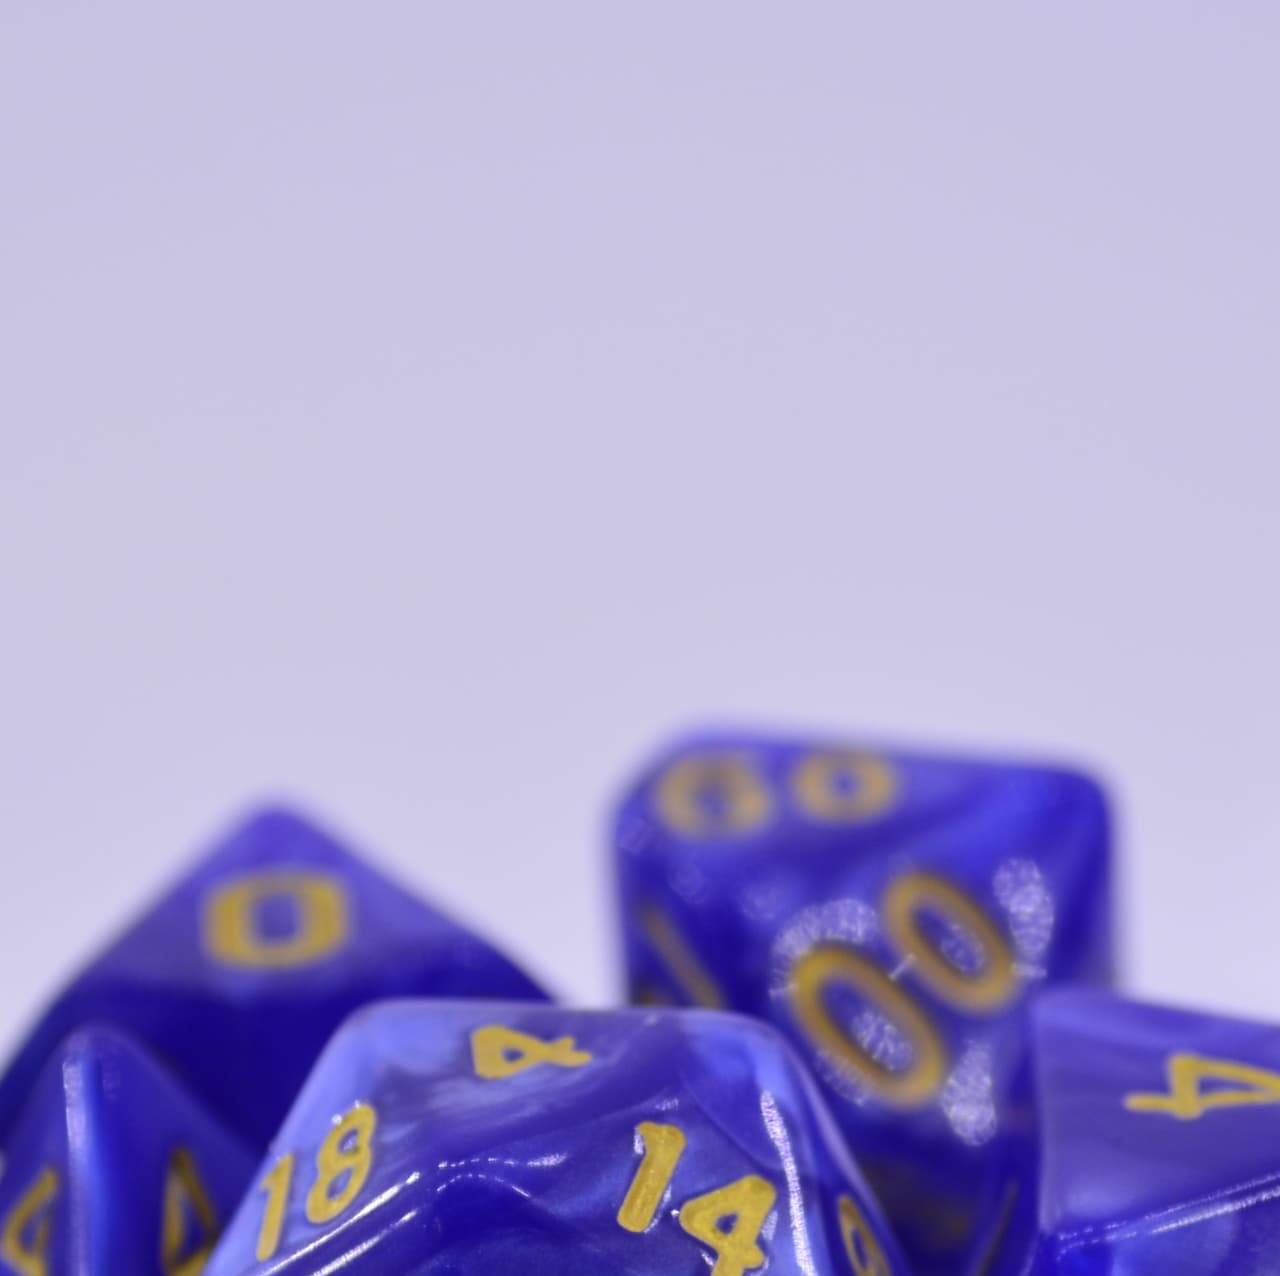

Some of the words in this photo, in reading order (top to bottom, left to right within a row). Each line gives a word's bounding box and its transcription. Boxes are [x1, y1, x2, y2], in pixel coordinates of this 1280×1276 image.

[204, 868, 348, 968] 0
[790, 868, 1022, 1106] 00
[470, 1024, 593, 1079] 4
[255, 1104, 377, 1261] 18
